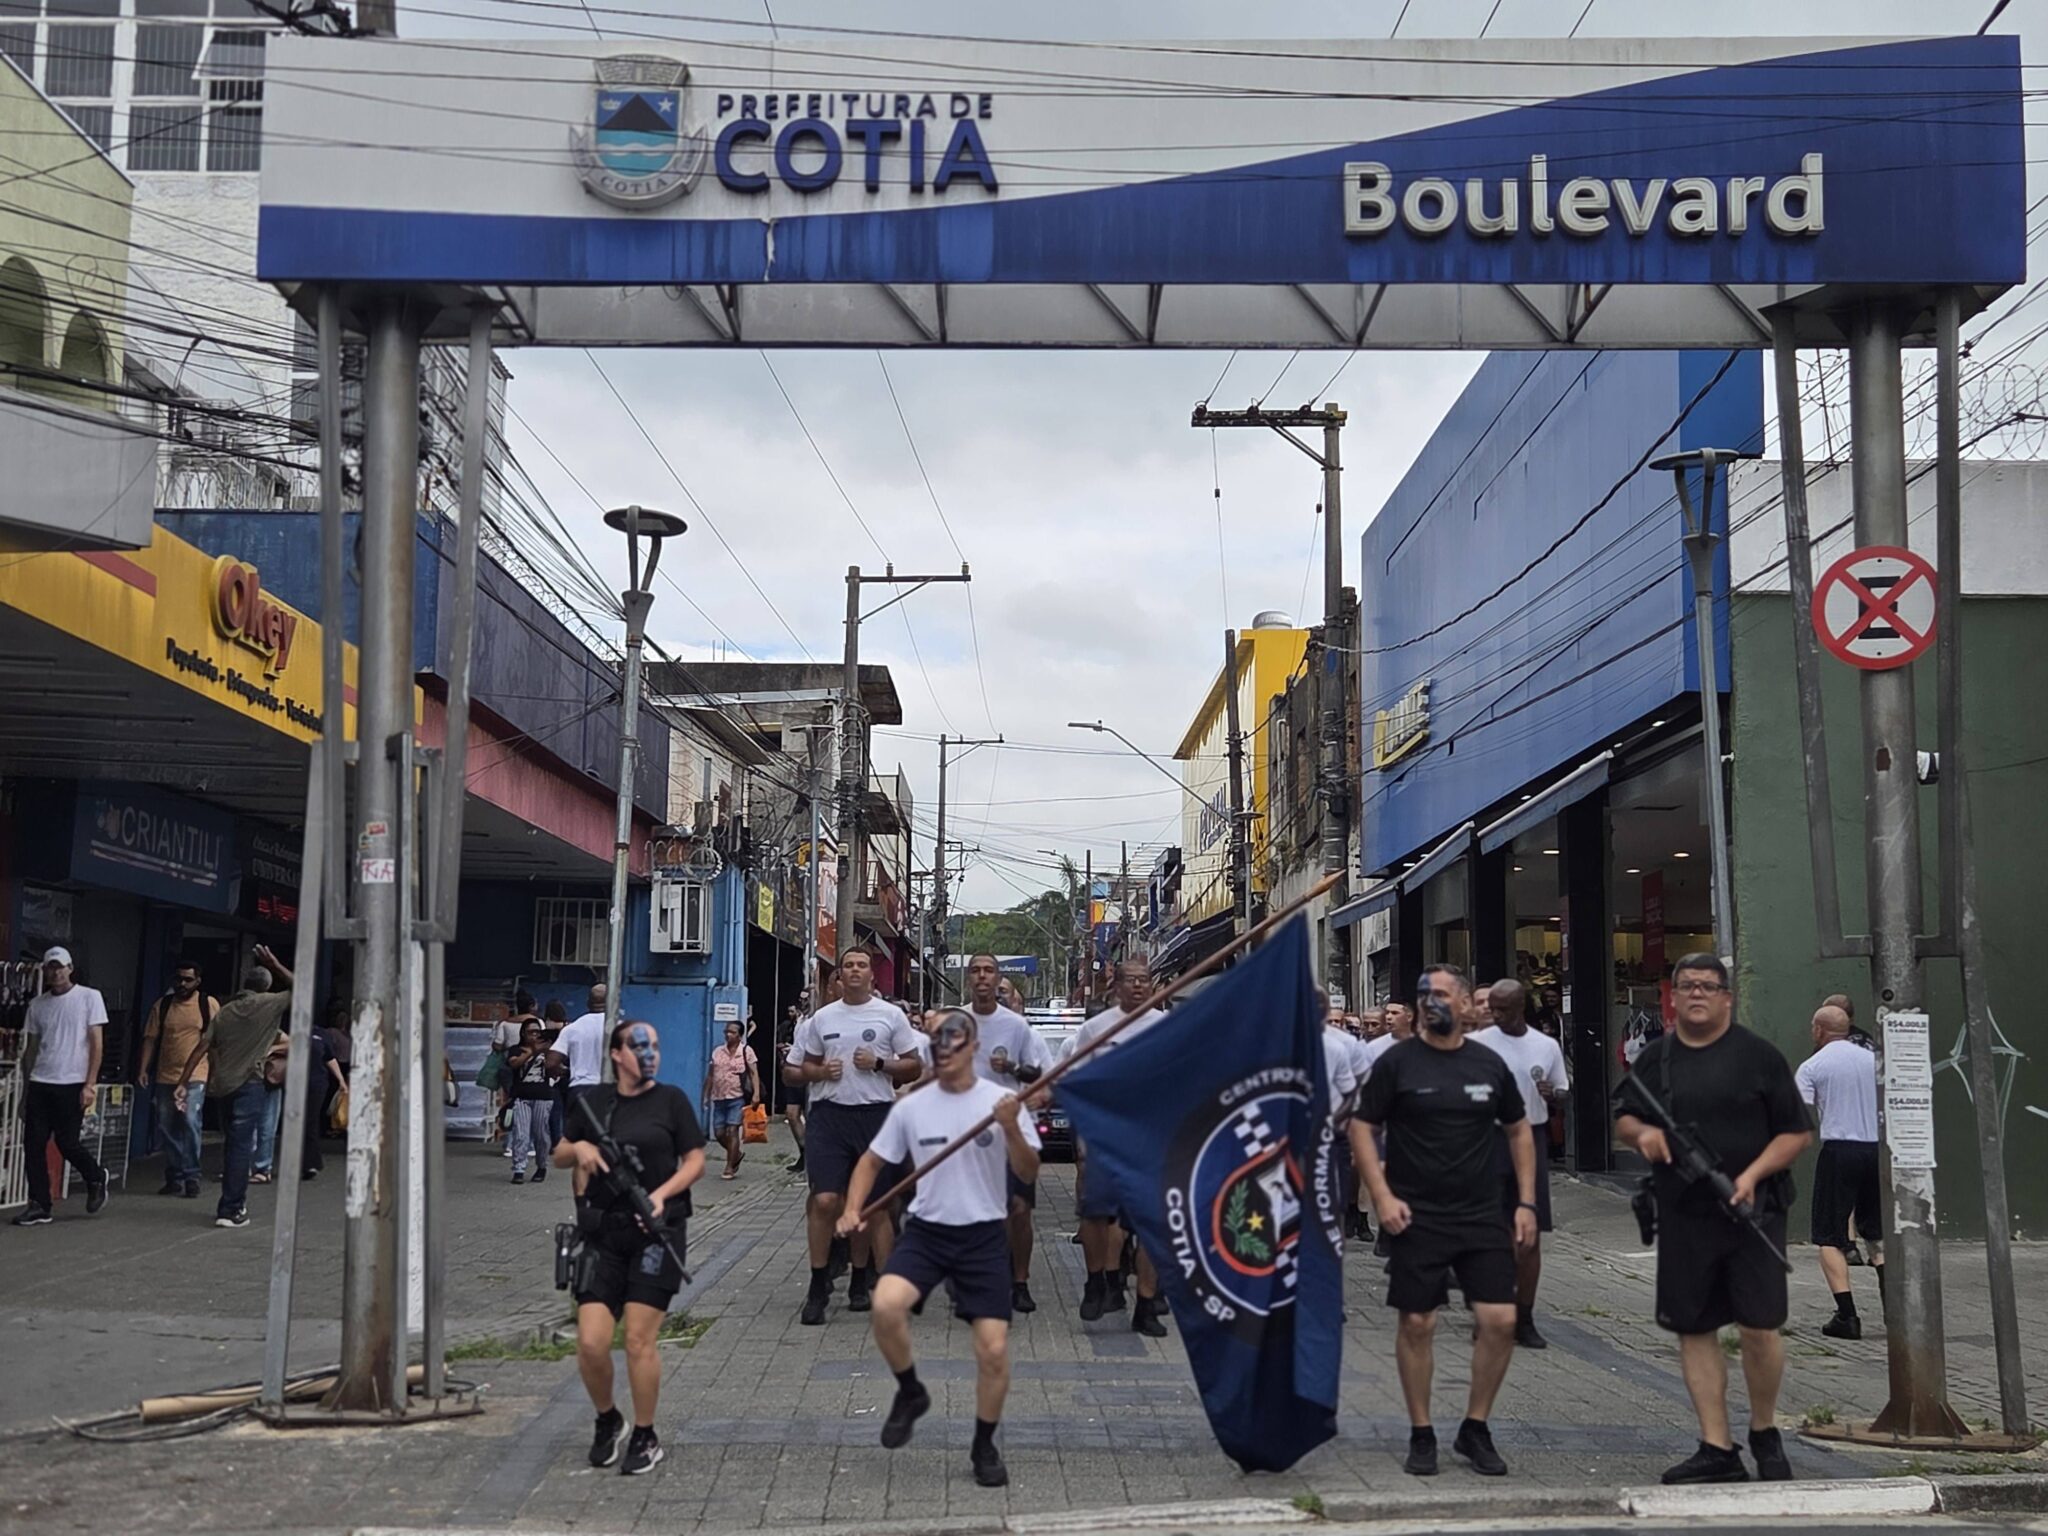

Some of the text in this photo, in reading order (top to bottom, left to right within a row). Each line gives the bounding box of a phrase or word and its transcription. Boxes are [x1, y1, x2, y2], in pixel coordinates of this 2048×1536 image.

[717, 93, 993, 120] PREFEITURA DE
[600, 175, 668, 194] COTIA
[714, 118, 999, 194] COTIA
[1343, 152, 1826, 237] Boulevard
[218, 562, 298, 672] Okey
[1220, 1067, 1295, 1106] CENTRO
[1166, 1187, 1196, 1280] COTIA
[1203, 1294, 1236, 1322] SP
